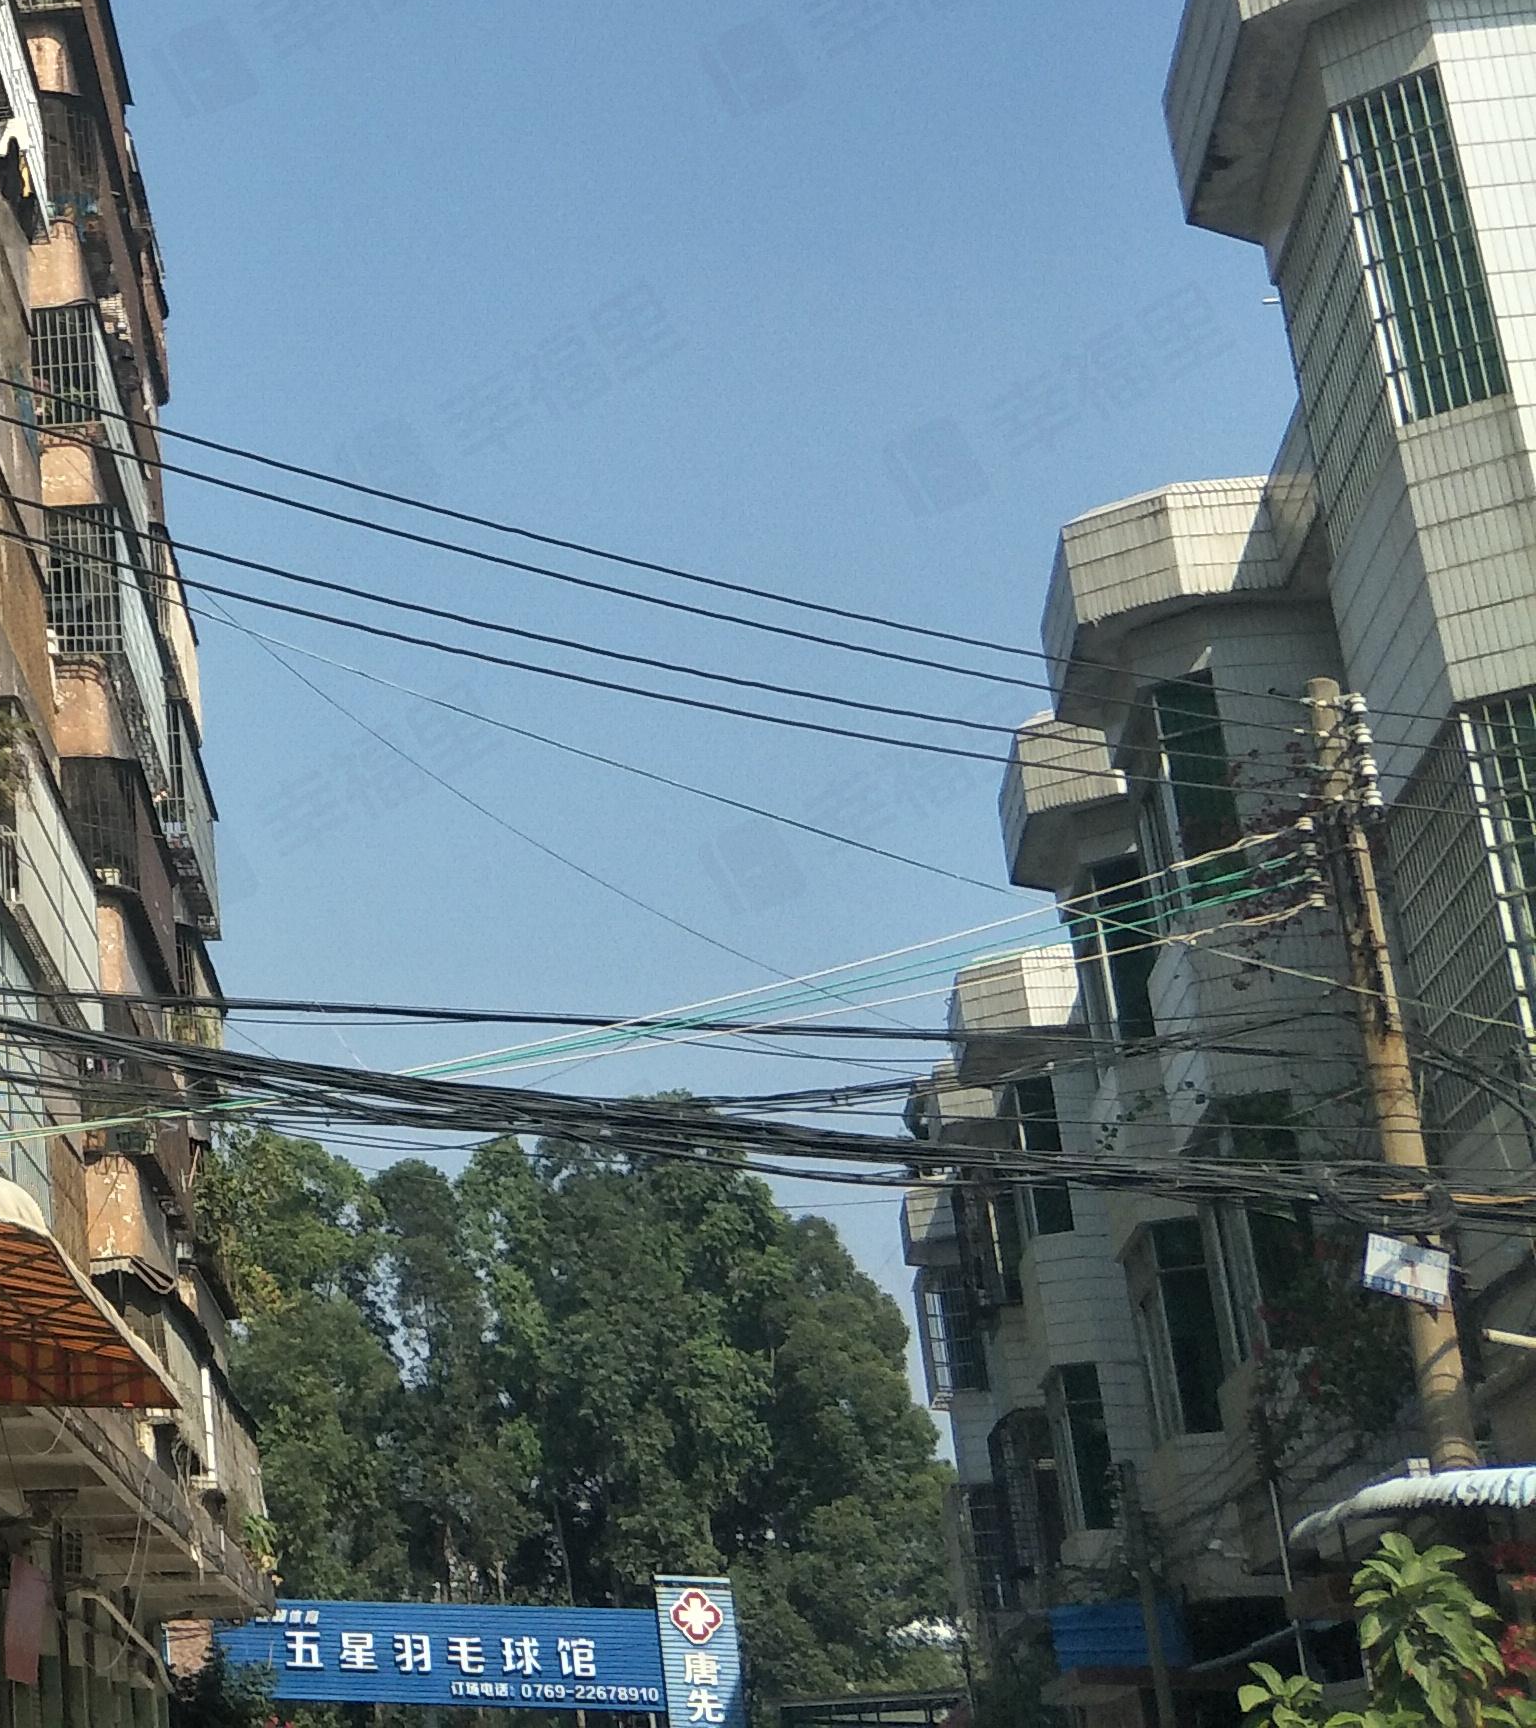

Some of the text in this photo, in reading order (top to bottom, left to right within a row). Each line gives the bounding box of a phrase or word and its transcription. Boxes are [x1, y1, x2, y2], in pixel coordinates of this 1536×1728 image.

[284, 1630, 597, 1678] 五星羽毛球馆
[521, 1683, 660, 1702] 0769-22678910
